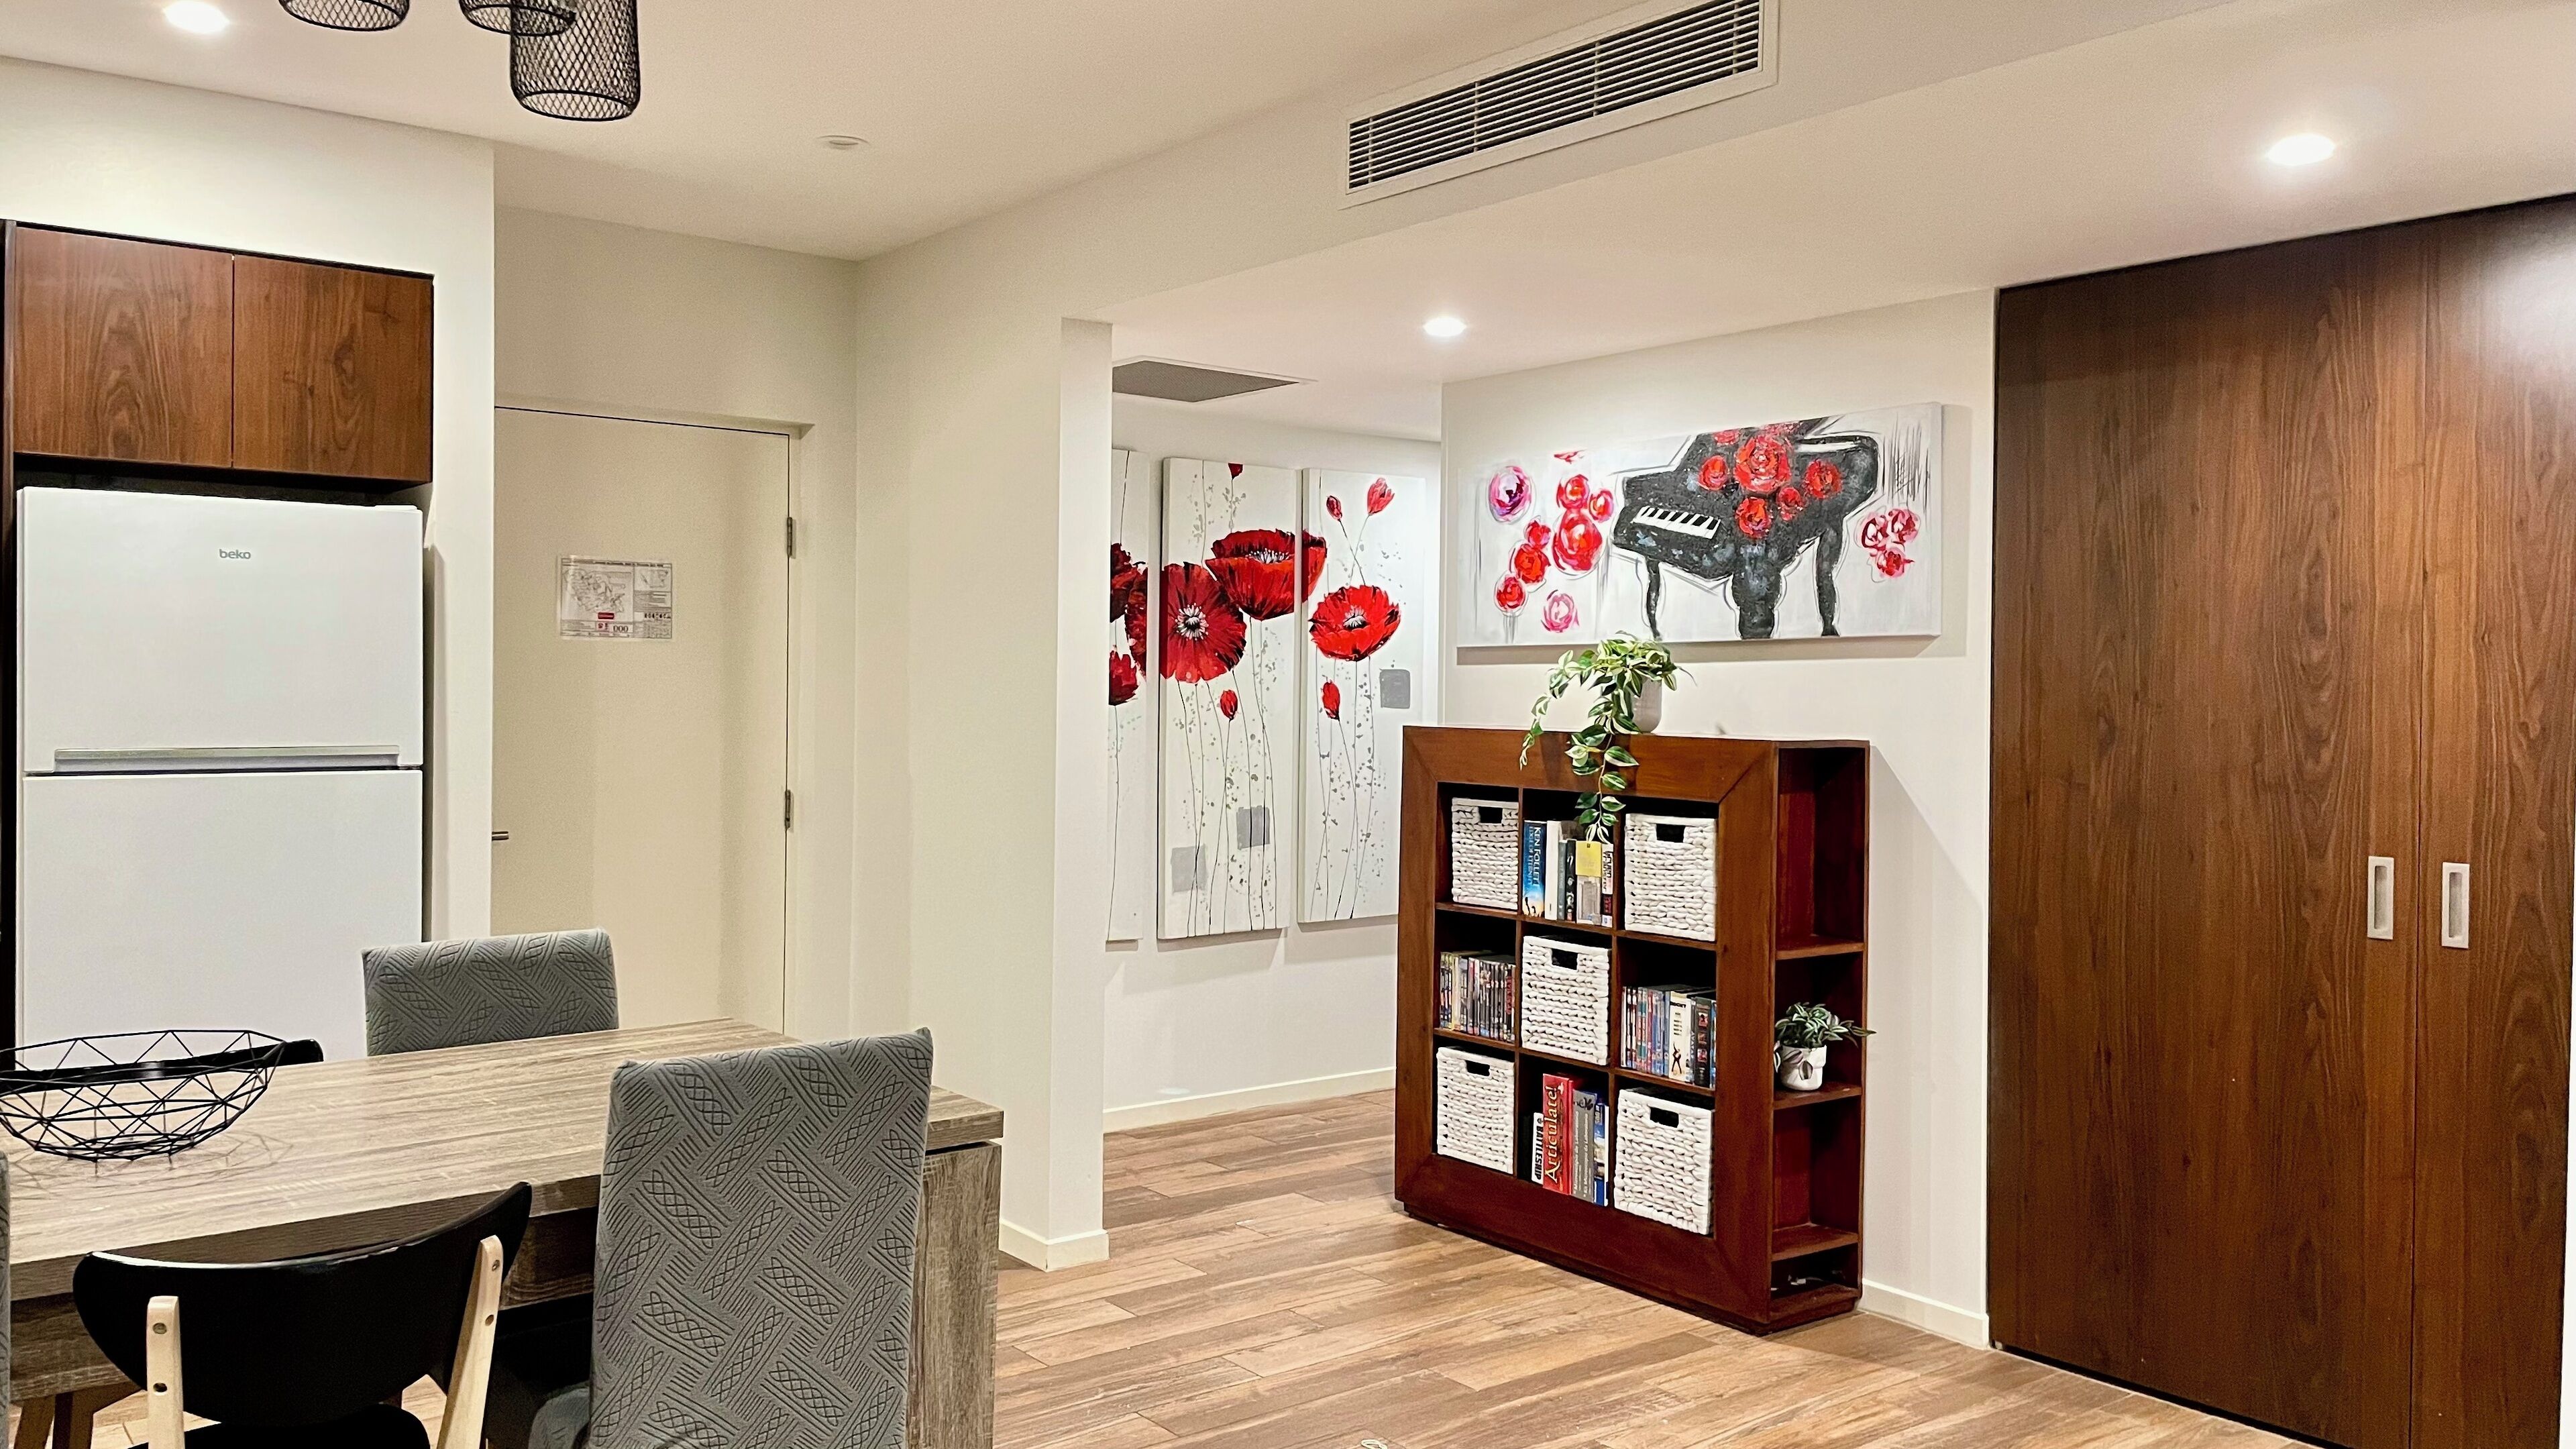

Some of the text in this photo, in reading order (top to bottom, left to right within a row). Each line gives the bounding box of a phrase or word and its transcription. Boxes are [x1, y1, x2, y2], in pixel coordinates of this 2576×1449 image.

[219, 548, 251, 559] beko
[1532, 826, 1542, 887] KEN FOLLETT
[1535, 1125, 1544, 1180] BATTLESHIP
[1544, 1085, 1560, 1184] Articulate!
